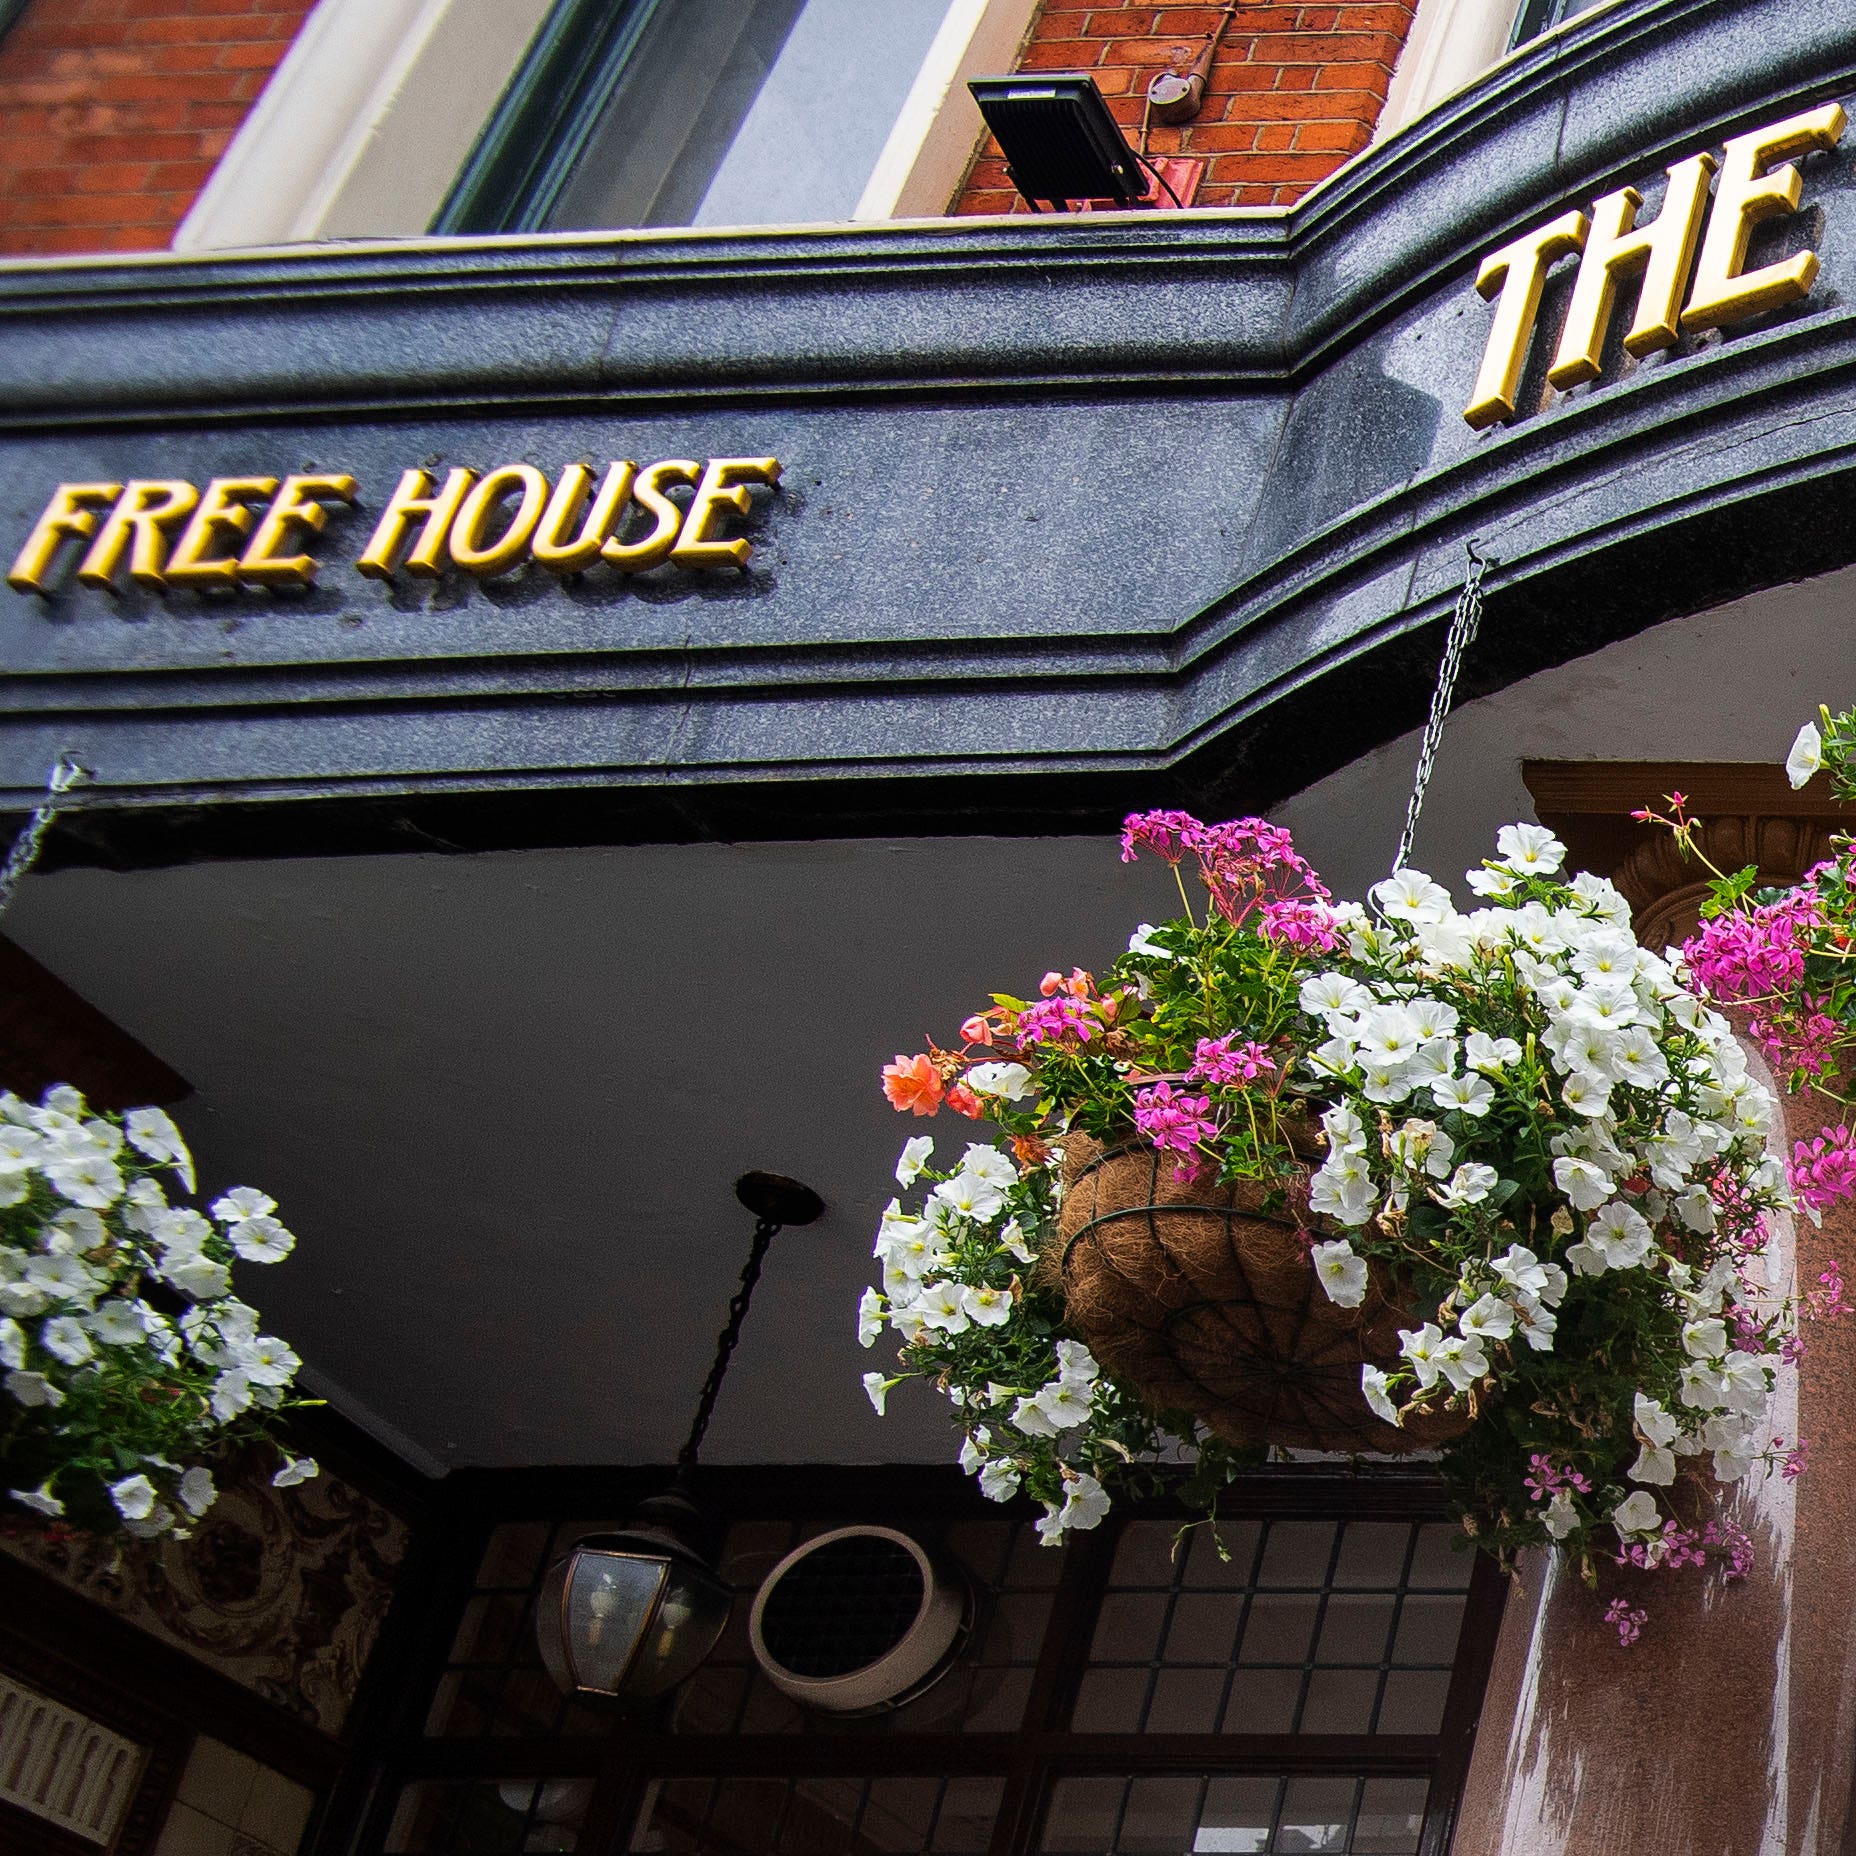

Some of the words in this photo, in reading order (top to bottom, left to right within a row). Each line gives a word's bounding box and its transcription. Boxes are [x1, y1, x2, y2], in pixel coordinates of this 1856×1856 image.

[1463, 101, 1849, 431] THE
[6, 472, 360, 593] FREE
[355, 456, 784, 580] HOUSE
